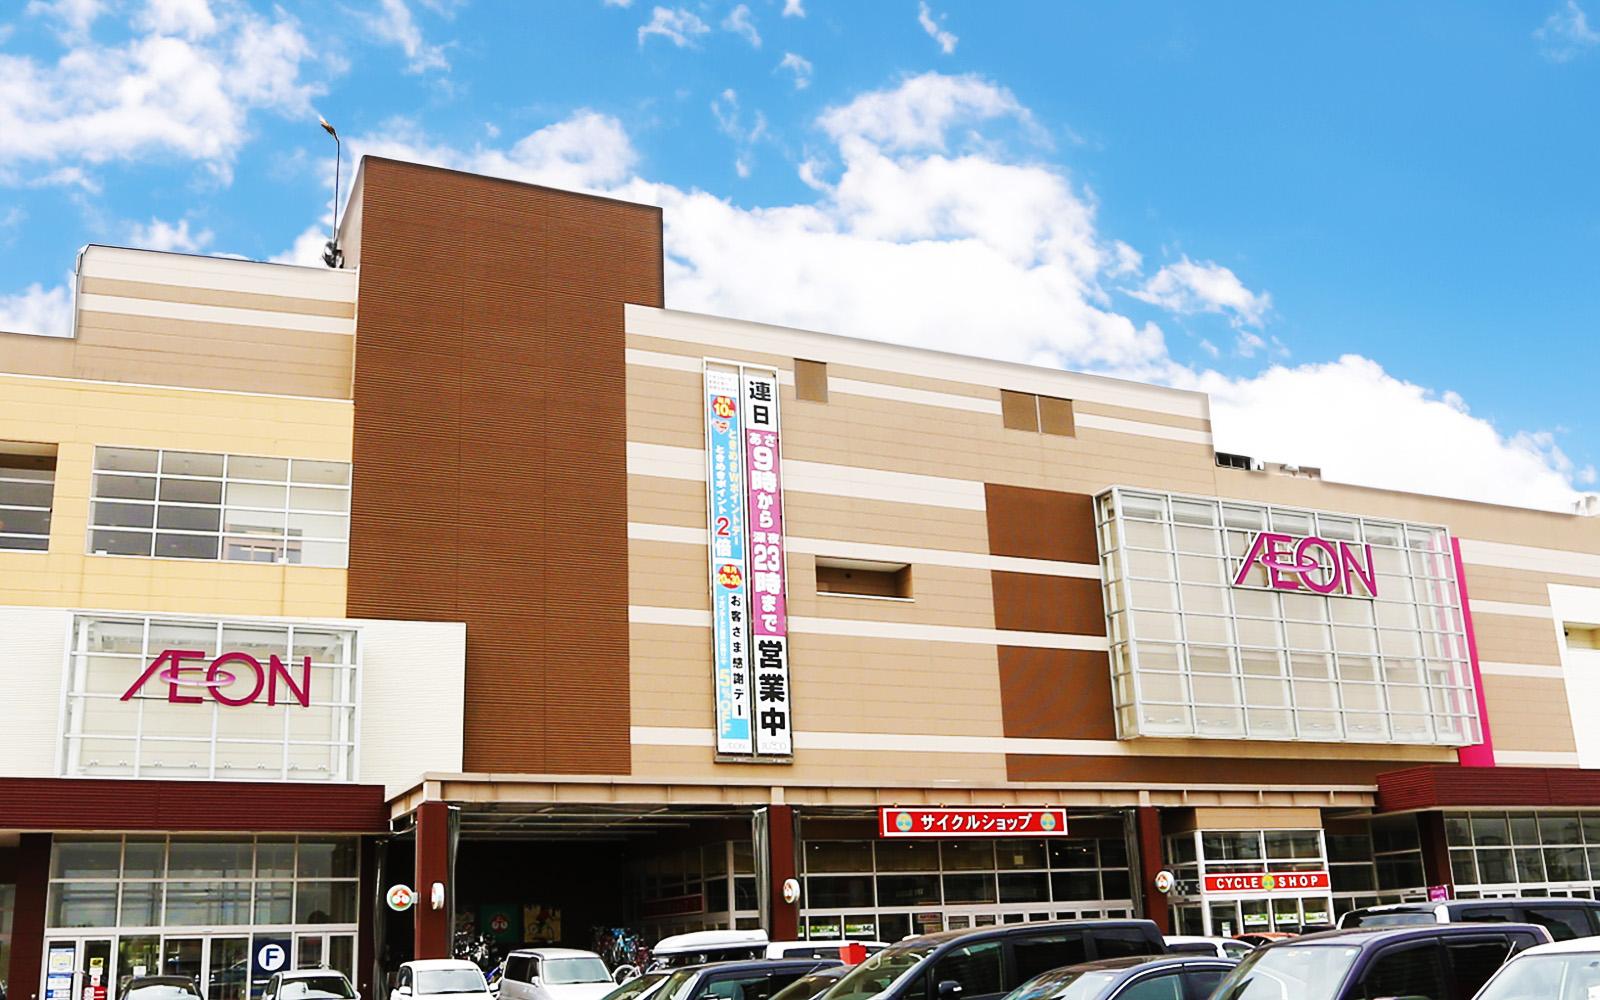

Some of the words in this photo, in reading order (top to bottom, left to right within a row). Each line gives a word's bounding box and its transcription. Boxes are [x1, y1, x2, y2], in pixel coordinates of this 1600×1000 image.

[758, 640, 786, 737] 営業中
[920, 812, 1033, 831] サイクルショップ
[1216, 877, 1259, 889] CYCLE
[1278, 875, 1319, 888] SHOP
[266, 948, 279, 966] F
